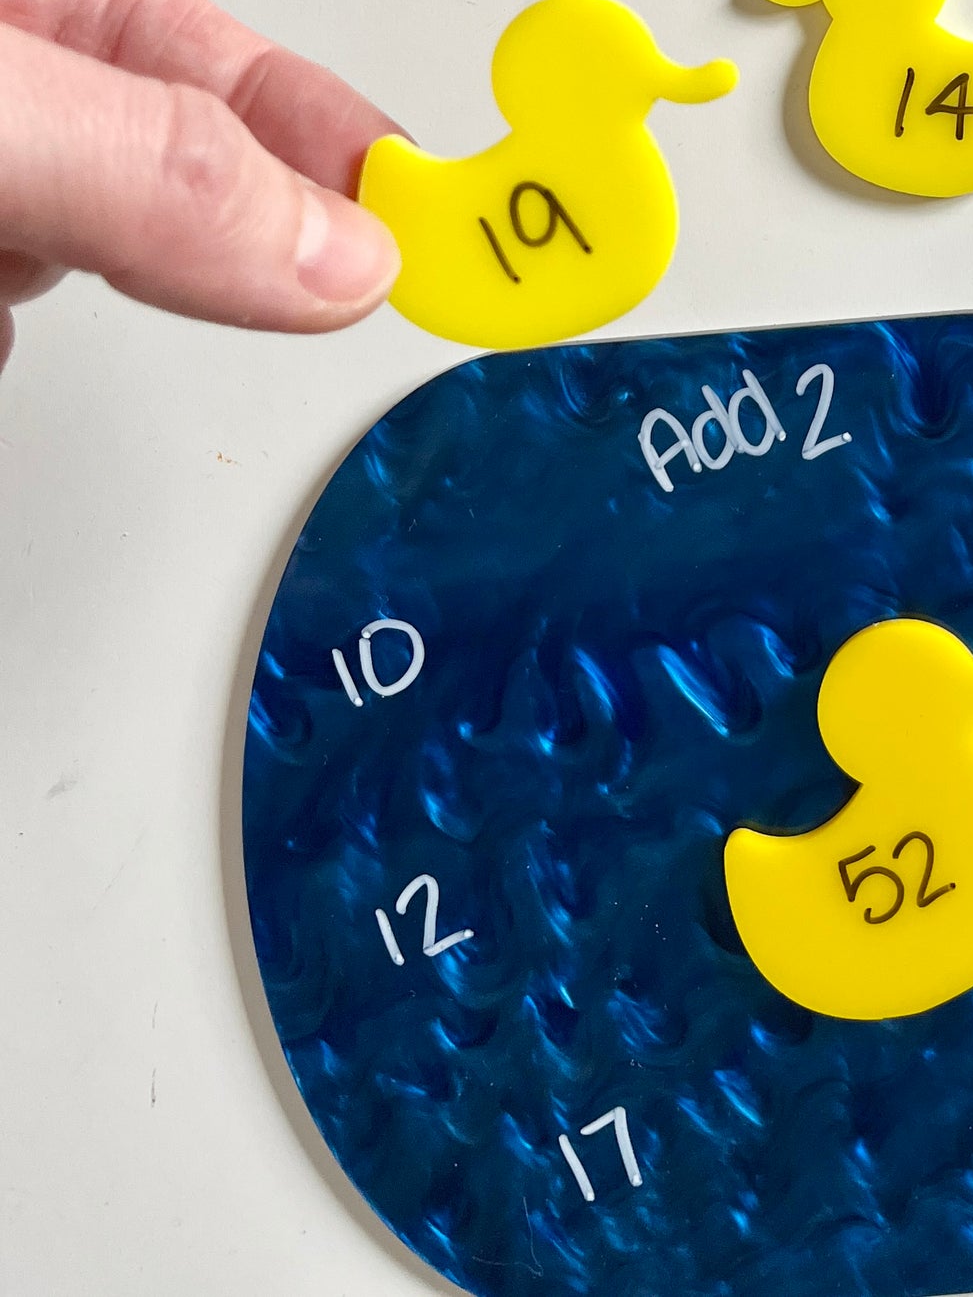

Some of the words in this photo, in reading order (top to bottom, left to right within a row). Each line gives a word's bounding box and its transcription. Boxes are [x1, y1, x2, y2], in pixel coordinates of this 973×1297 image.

[480, 178, 591, 284] 19
[637, 369, 786, 493] Add
[798, 364, 851, 460] 2
[331, 618, 426, 707] 10
[374, 873, 474, 965] 12
[837, 830, 956, 924] 52
[557, 1106, 643, 1202] 17
